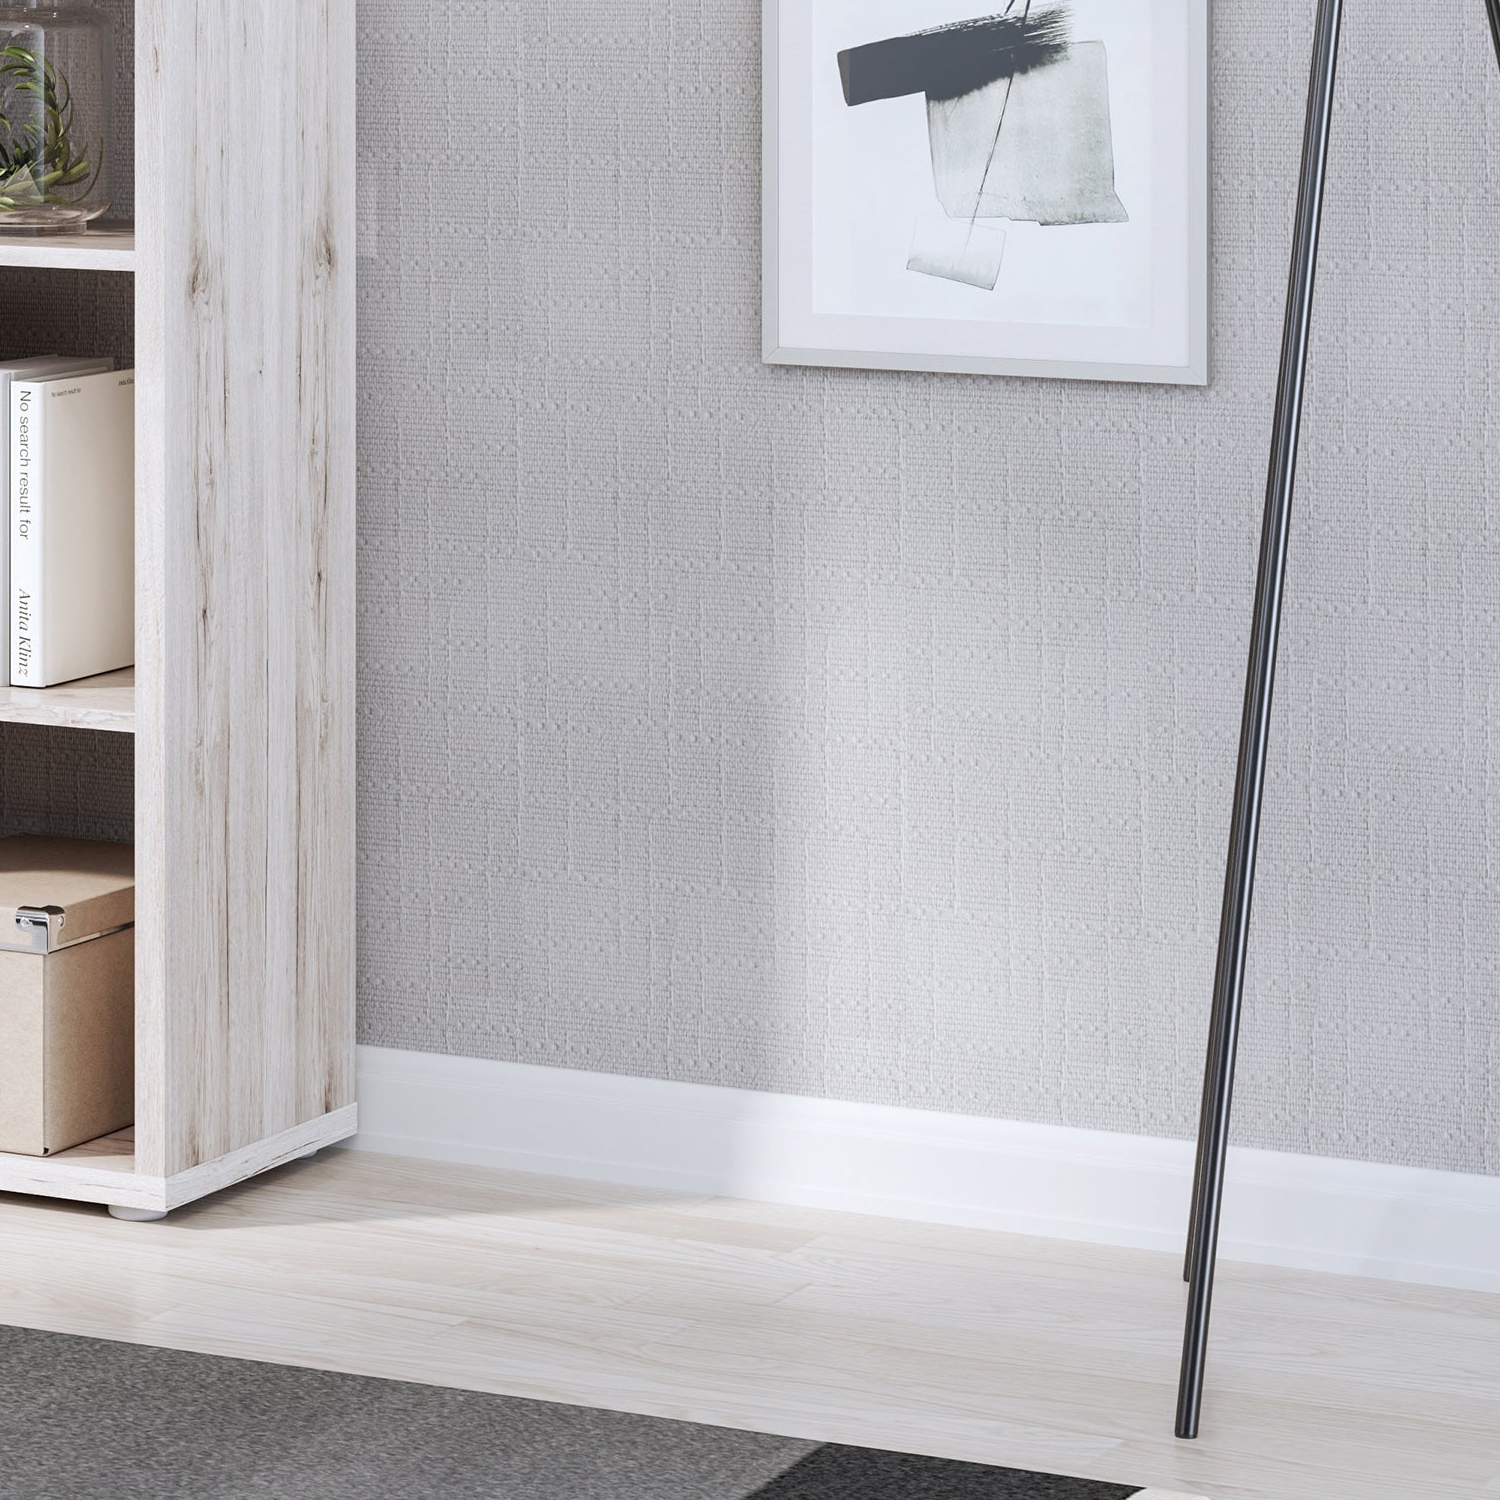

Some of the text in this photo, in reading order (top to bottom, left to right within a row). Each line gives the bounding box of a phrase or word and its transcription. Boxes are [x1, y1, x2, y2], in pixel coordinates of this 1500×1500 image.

[19, 390, 32, 540] No search result for
[18, 588, 32, 677] Anita Klinz
